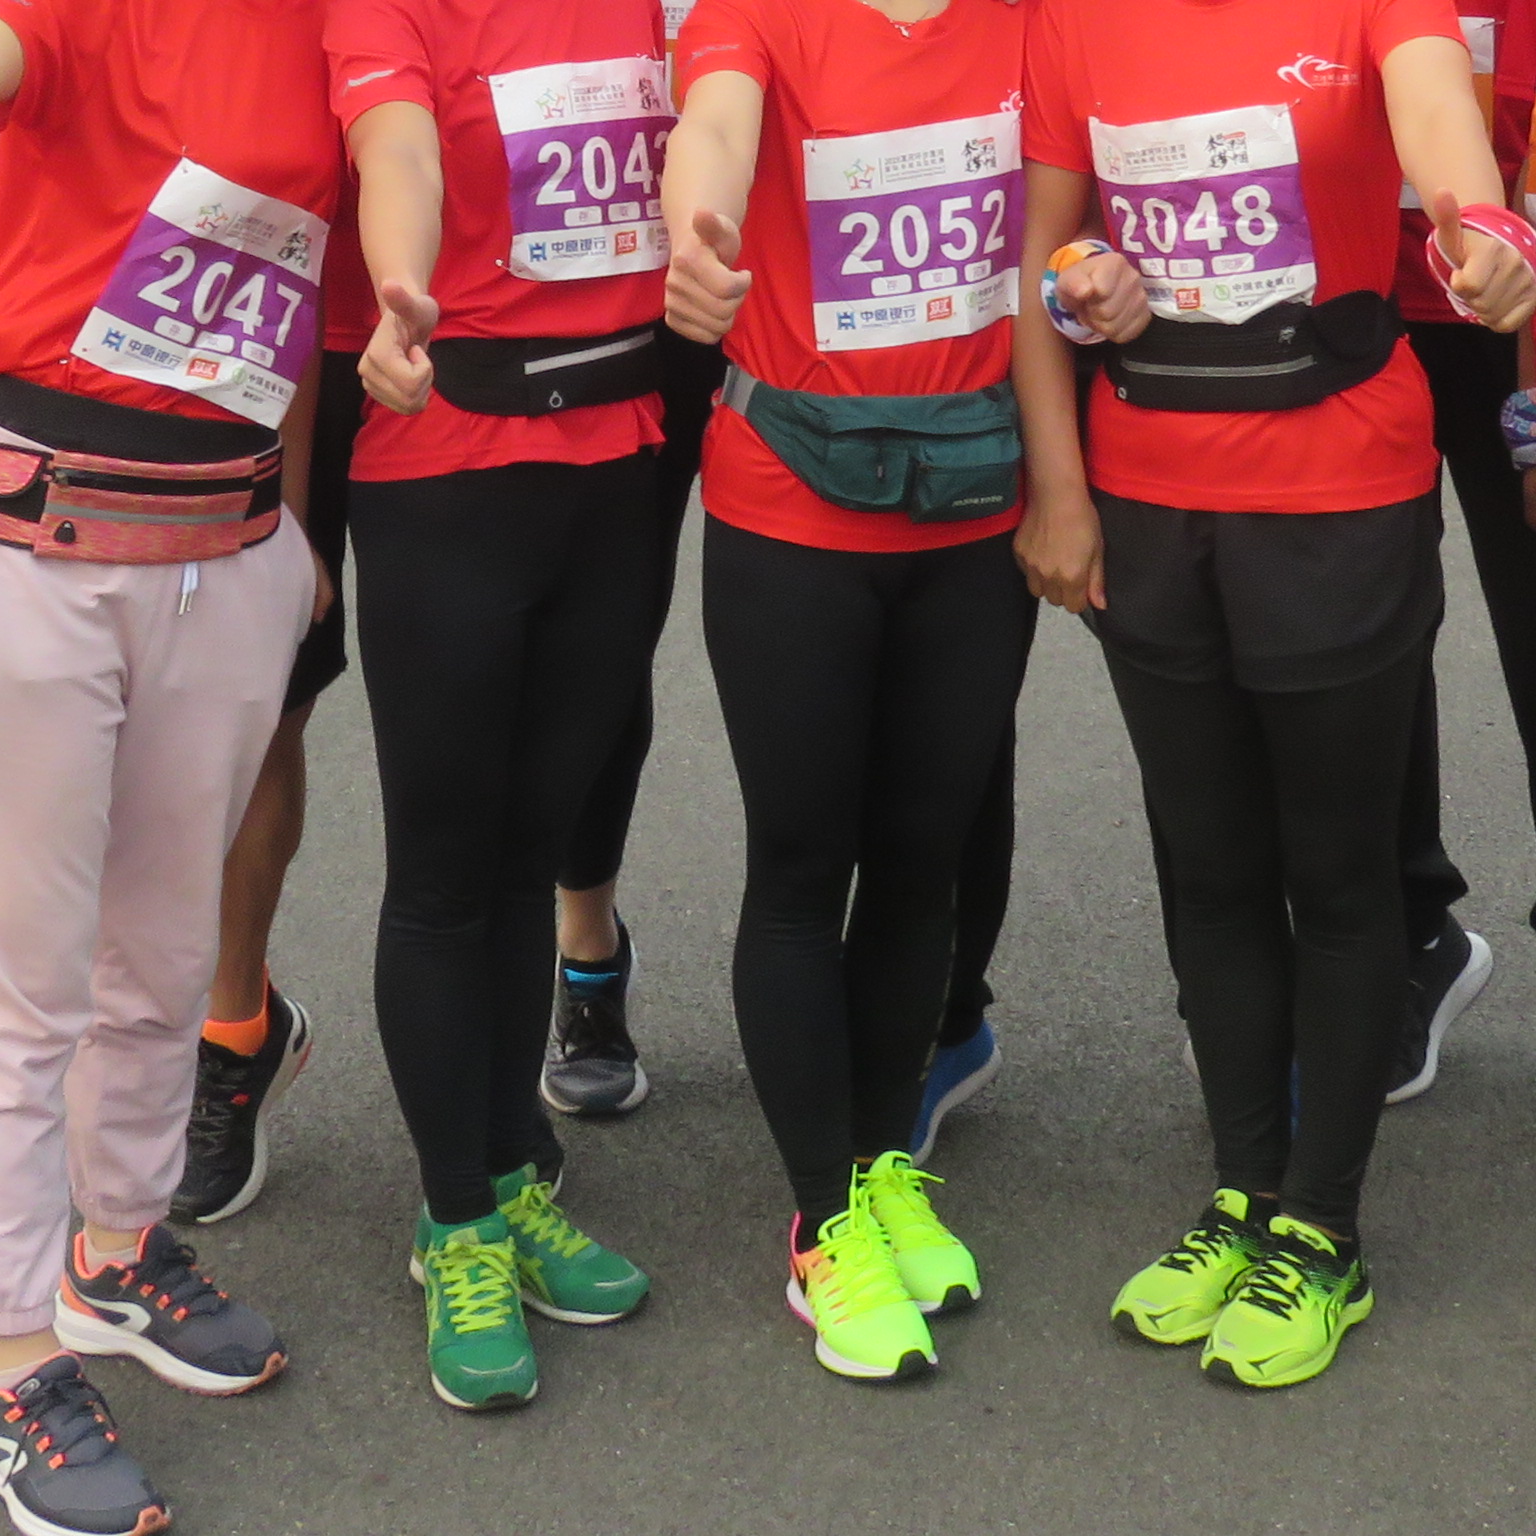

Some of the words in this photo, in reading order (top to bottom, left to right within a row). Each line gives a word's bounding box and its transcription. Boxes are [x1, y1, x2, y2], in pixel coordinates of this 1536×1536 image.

[839, 189, 1005, 275] 2052
[1110, 185, 1278, 254] 2048
[137, 245, 303, 347] 2047
